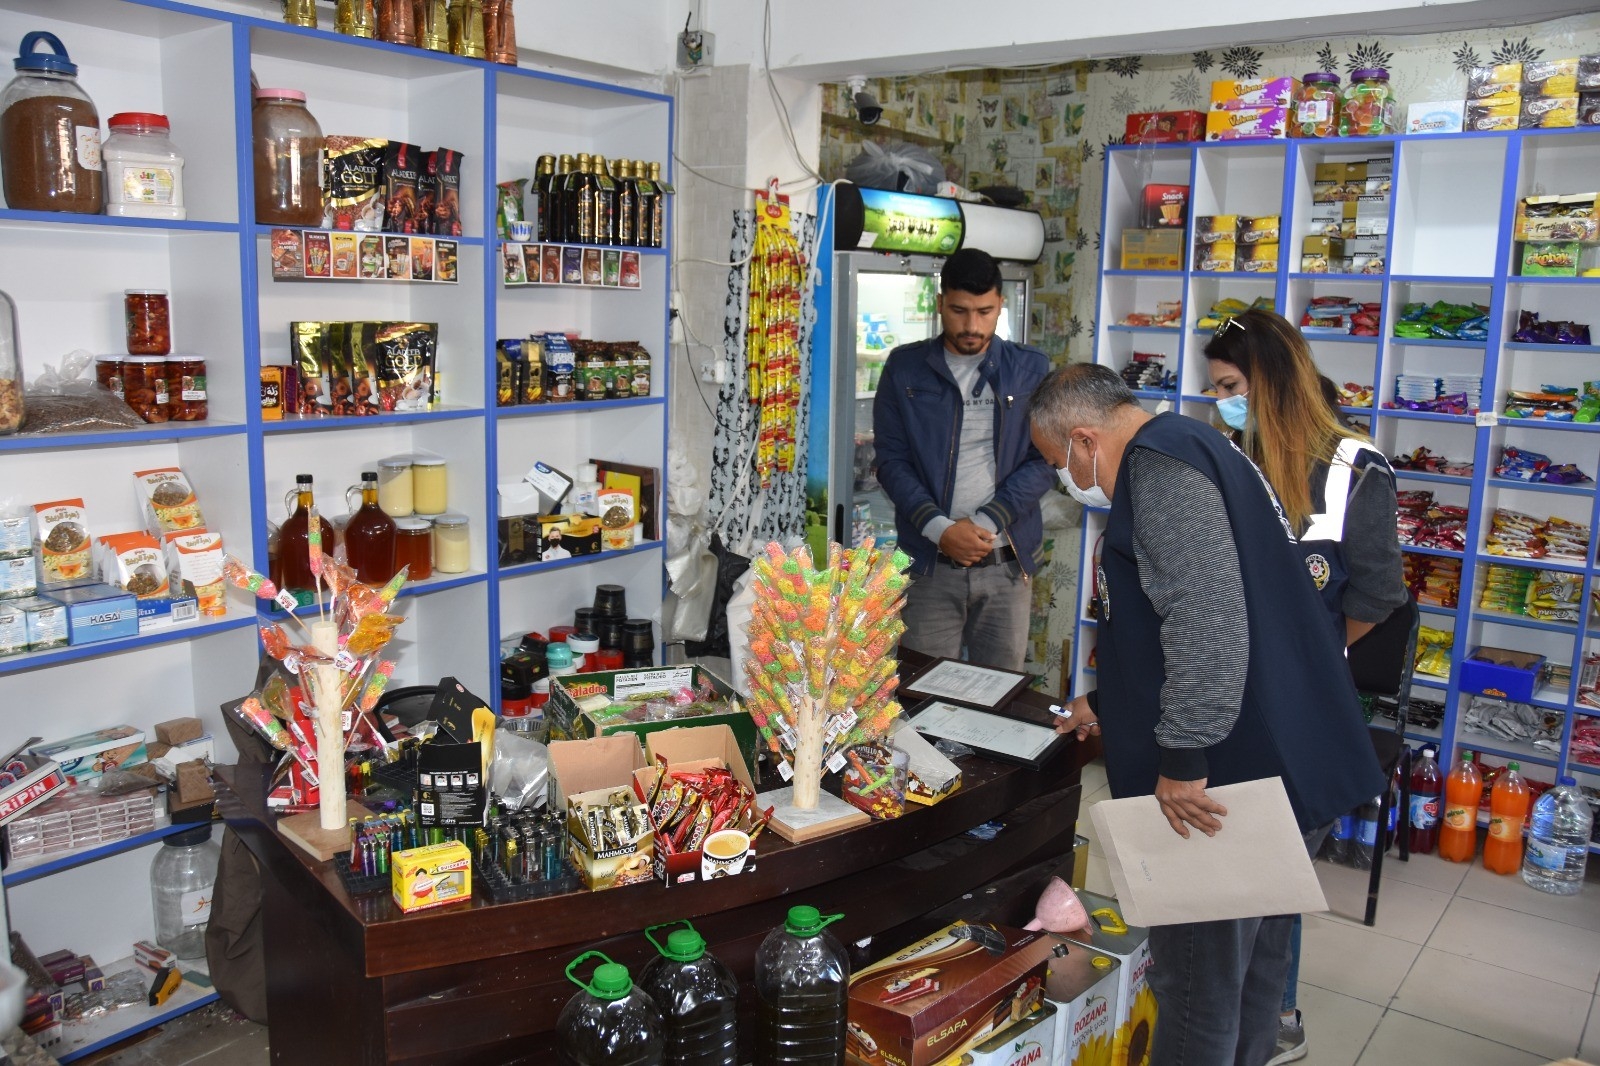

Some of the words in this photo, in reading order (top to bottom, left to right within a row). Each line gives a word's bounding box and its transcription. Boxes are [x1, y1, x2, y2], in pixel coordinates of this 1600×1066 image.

[1162, 192, 1184, 201] Snack
[597, 845, 636, 860] MAHMOOD
[896, 936, 944, 961] ELSAFA
[1073, 1001, 1107, 1035] ROZANA
[926, 1018, 967, 1047] ELSAFA
